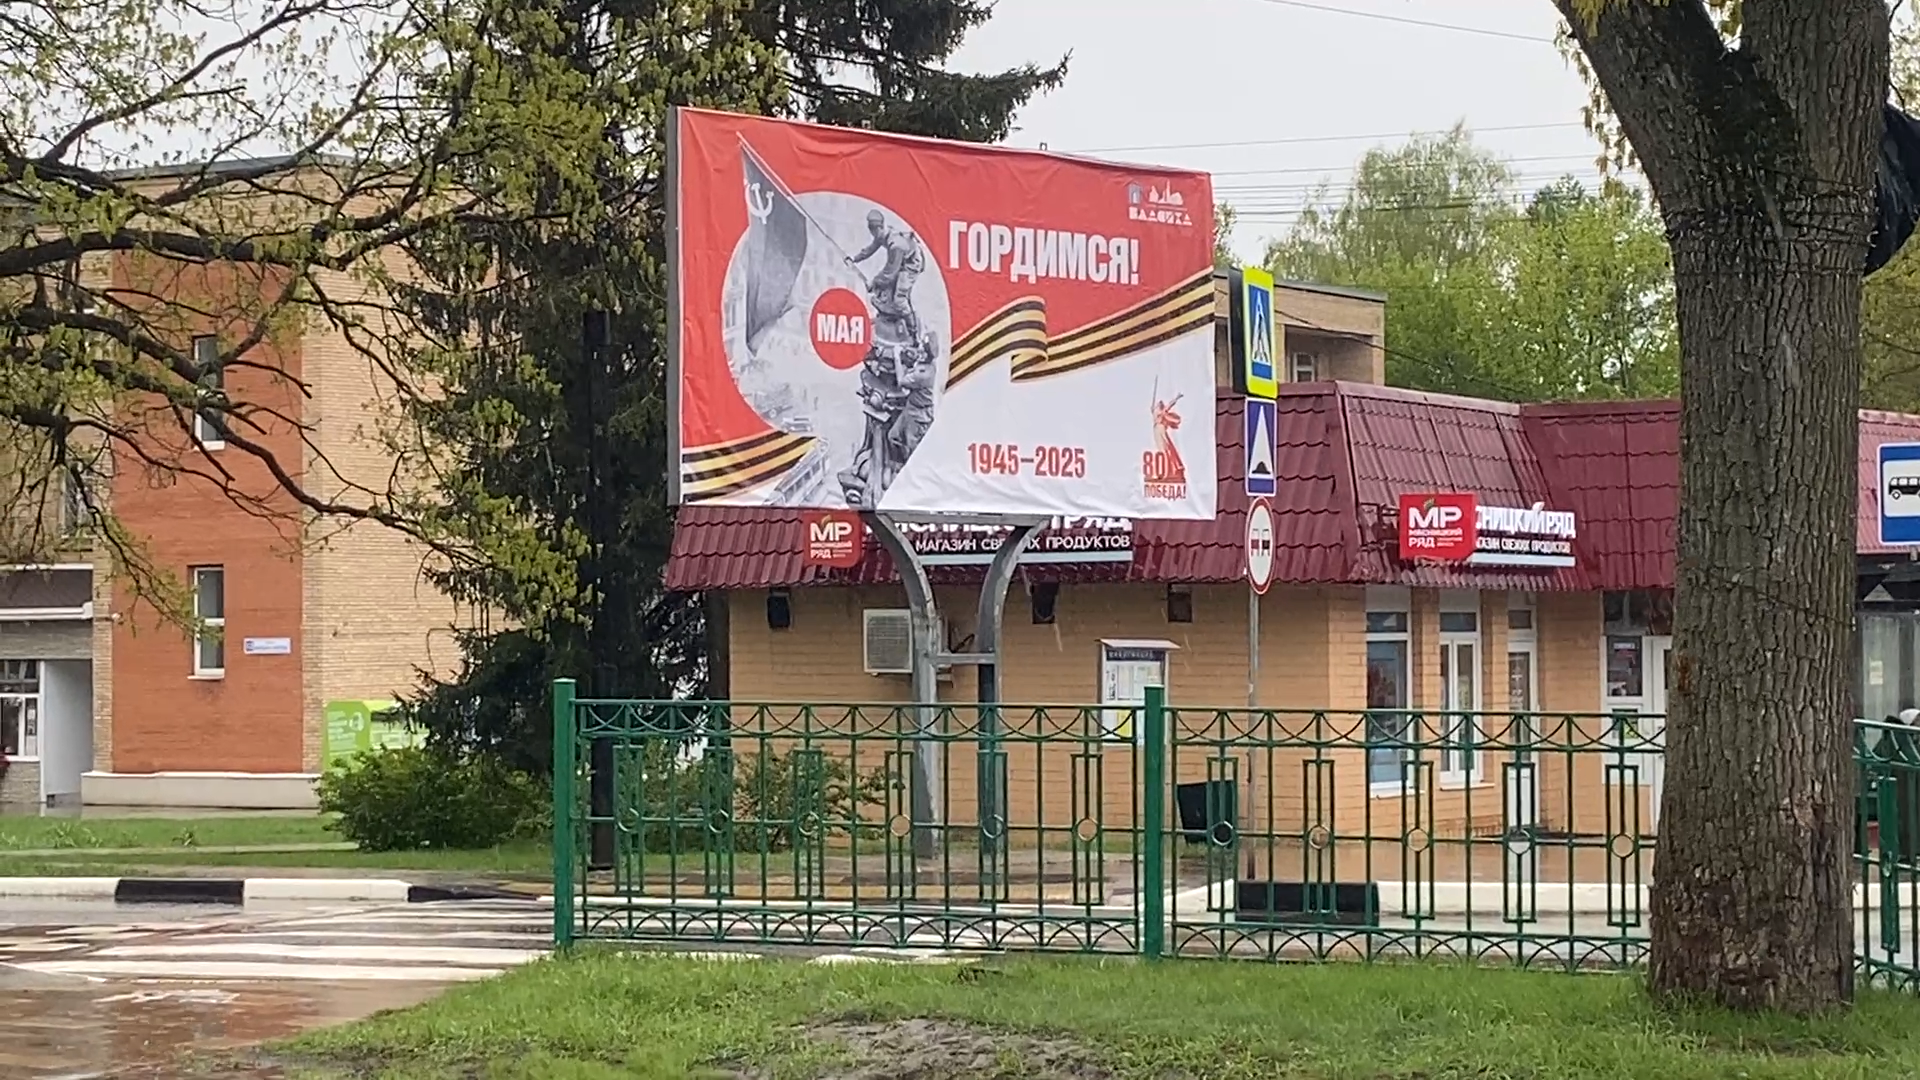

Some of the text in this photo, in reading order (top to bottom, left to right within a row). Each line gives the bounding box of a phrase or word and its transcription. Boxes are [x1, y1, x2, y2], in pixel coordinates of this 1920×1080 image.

[949, 220, 1140, 285] ГОРДИМСЯ!
[816, 312, 865, 345] МАЯ
[1143, 451, 1165, 480] 80
[1143, 484, 1187, 501] ПОБЕДА!
[915, 538, 977, 552] МАГАЗИН
[1045, 534, 1131, 550] ПРОДУКТОВ
[1408, 537, 1436, 548] РЯД
